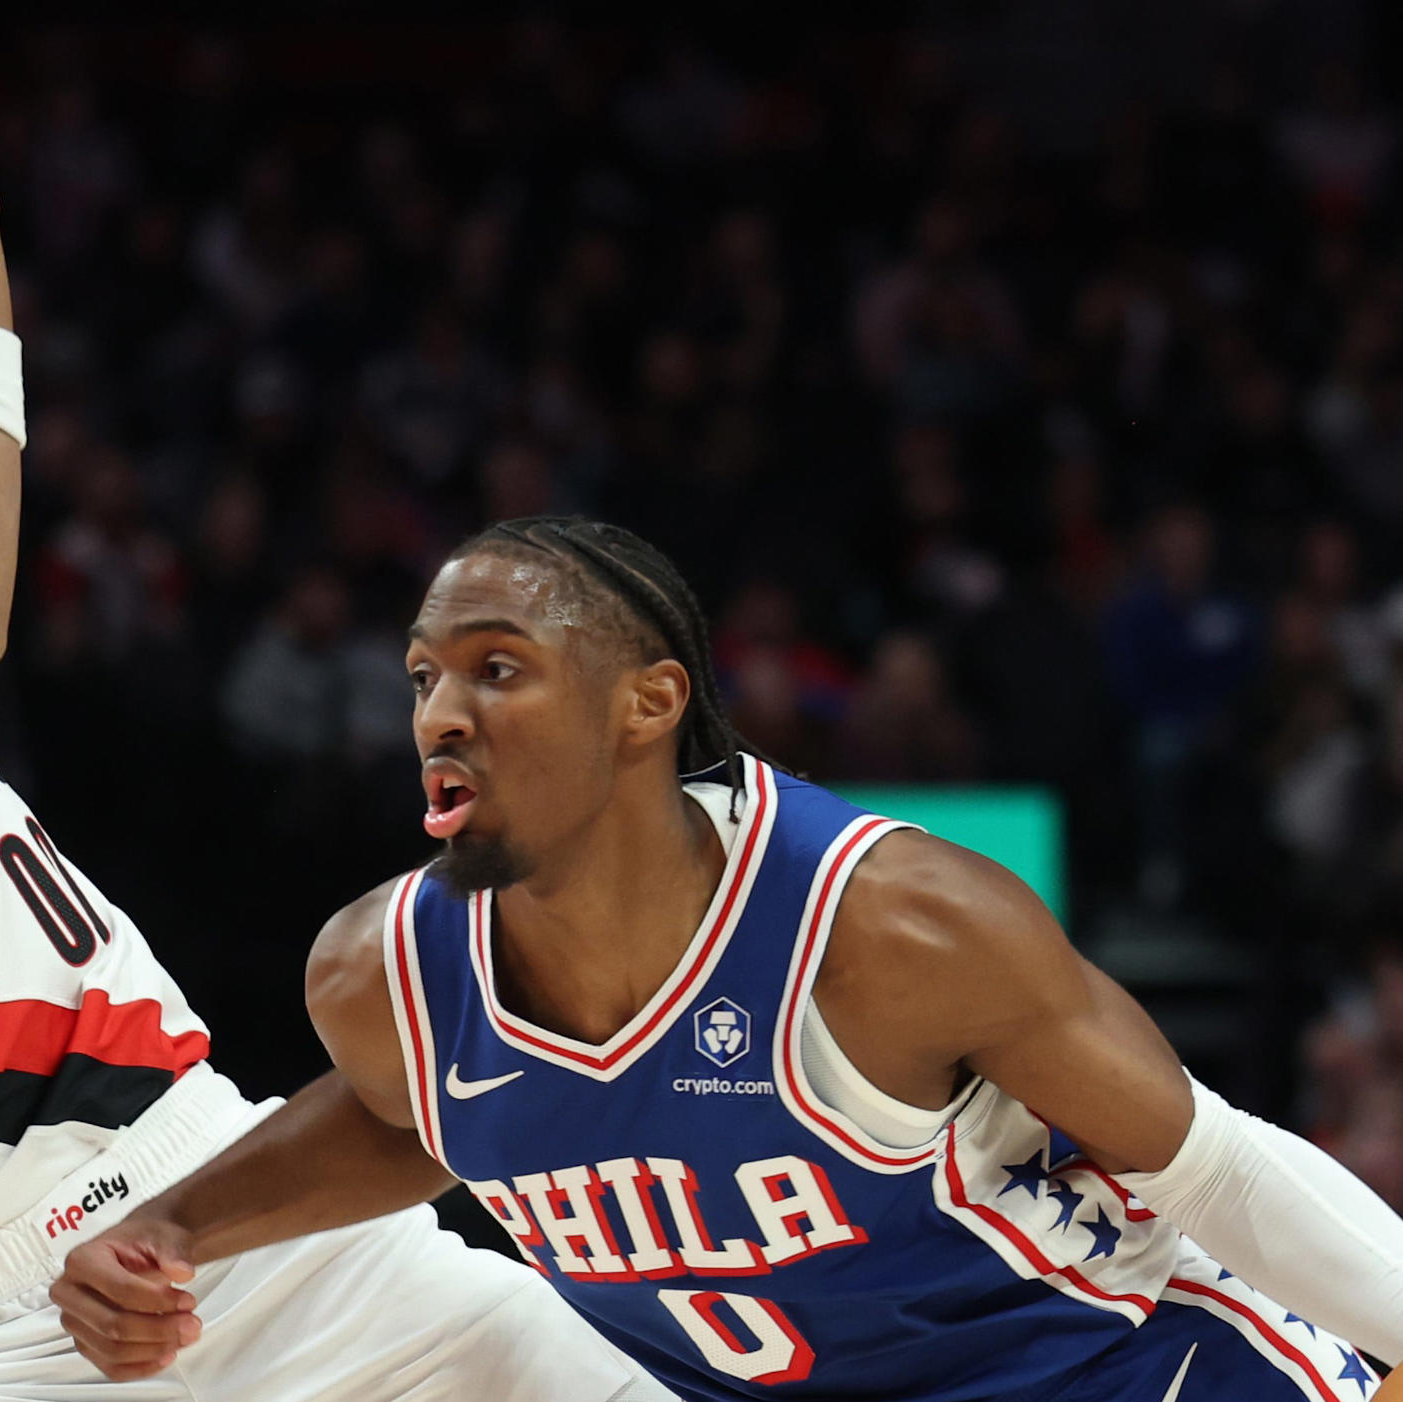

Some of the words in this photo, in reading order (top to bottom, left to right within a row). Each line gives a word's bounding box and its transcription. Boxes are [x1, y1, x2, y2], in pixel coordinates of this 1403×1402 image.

[672, 1077, 774, 1096] crypto.com
[45, 1171, 129, 1239] ripcity
[464, 1155, 869, 1282] PHILA
[658, 1289, 816, 1386] 0
